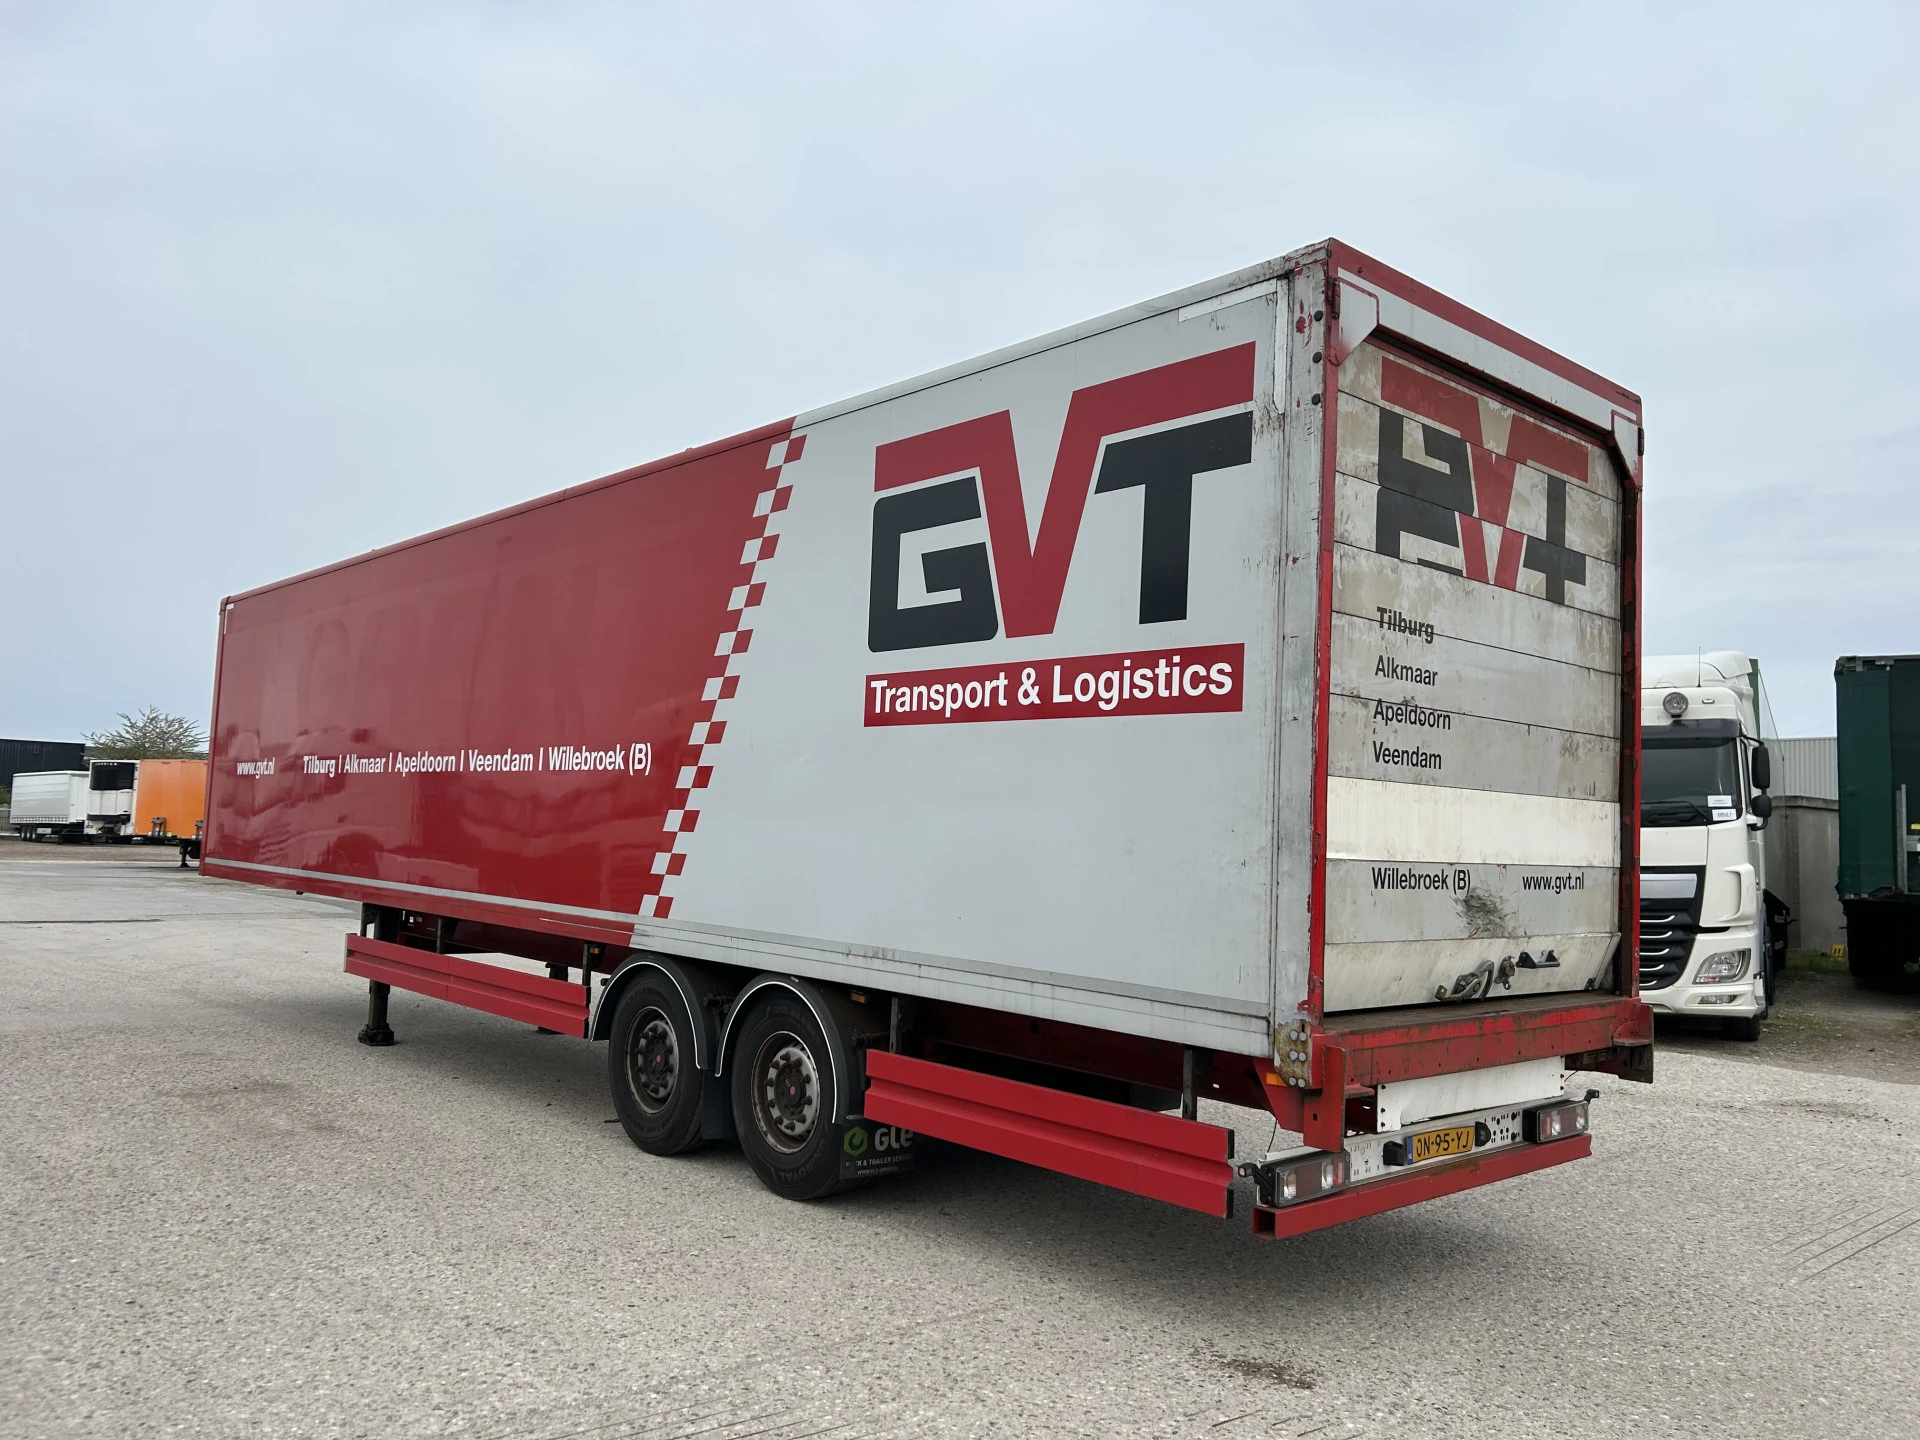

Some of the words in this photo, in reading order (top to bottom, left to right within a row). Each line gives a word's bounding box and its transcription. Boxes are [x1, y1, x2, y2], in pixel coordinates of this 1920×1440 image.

[868, 341, 1256, 653] GVT
[1376, 606, 1435, 645] Tilburg
[870, 671, 1009, 718] Transport
[1017, 667, 1042, 706] &
[1052, 655, 1233, 711] Logistics
[1374, 654, 1438, 687] Alkmaar
[1373, 698, 1451, 731] Apeldoorn
[236, 756, 275, 780] www.gvt.nl
[303, 755, 336, 778] Tilburg
[344, 753, 386, 774] Alkmaar
[395, 750, 456, 778] Apeldoorn
[468, 748, 534, 772] Veendam
[548, 743, 626, 771] Willebroek
[628, 742, 652, 776] (B)
[1373, 740, 1442, 770] Veendam
[1371, 866, 1449, 891] Willebroek
[1453, 869, 1471, 896] (B)
[1522, 871, 1585, 895] www.gvt.nl
